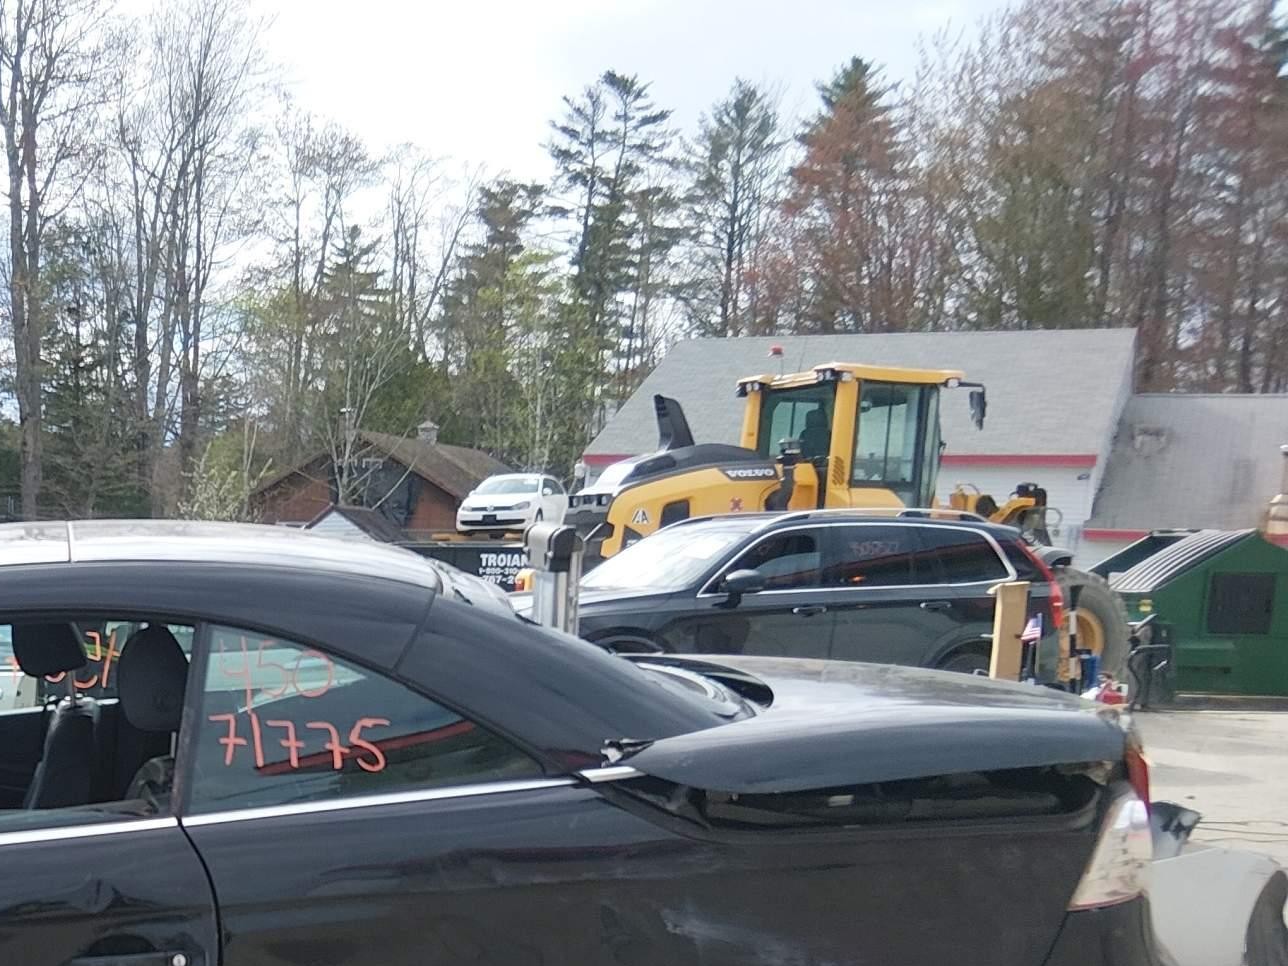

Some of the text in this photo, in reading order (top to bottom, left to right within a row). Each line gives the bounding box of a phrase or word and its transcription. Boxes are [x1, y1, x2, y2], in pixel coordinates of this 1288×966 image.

[725, 469, 775, 478] VOLVO
[219, 635, 334, 713] 450
[208, 713, 391, 772] 71775
